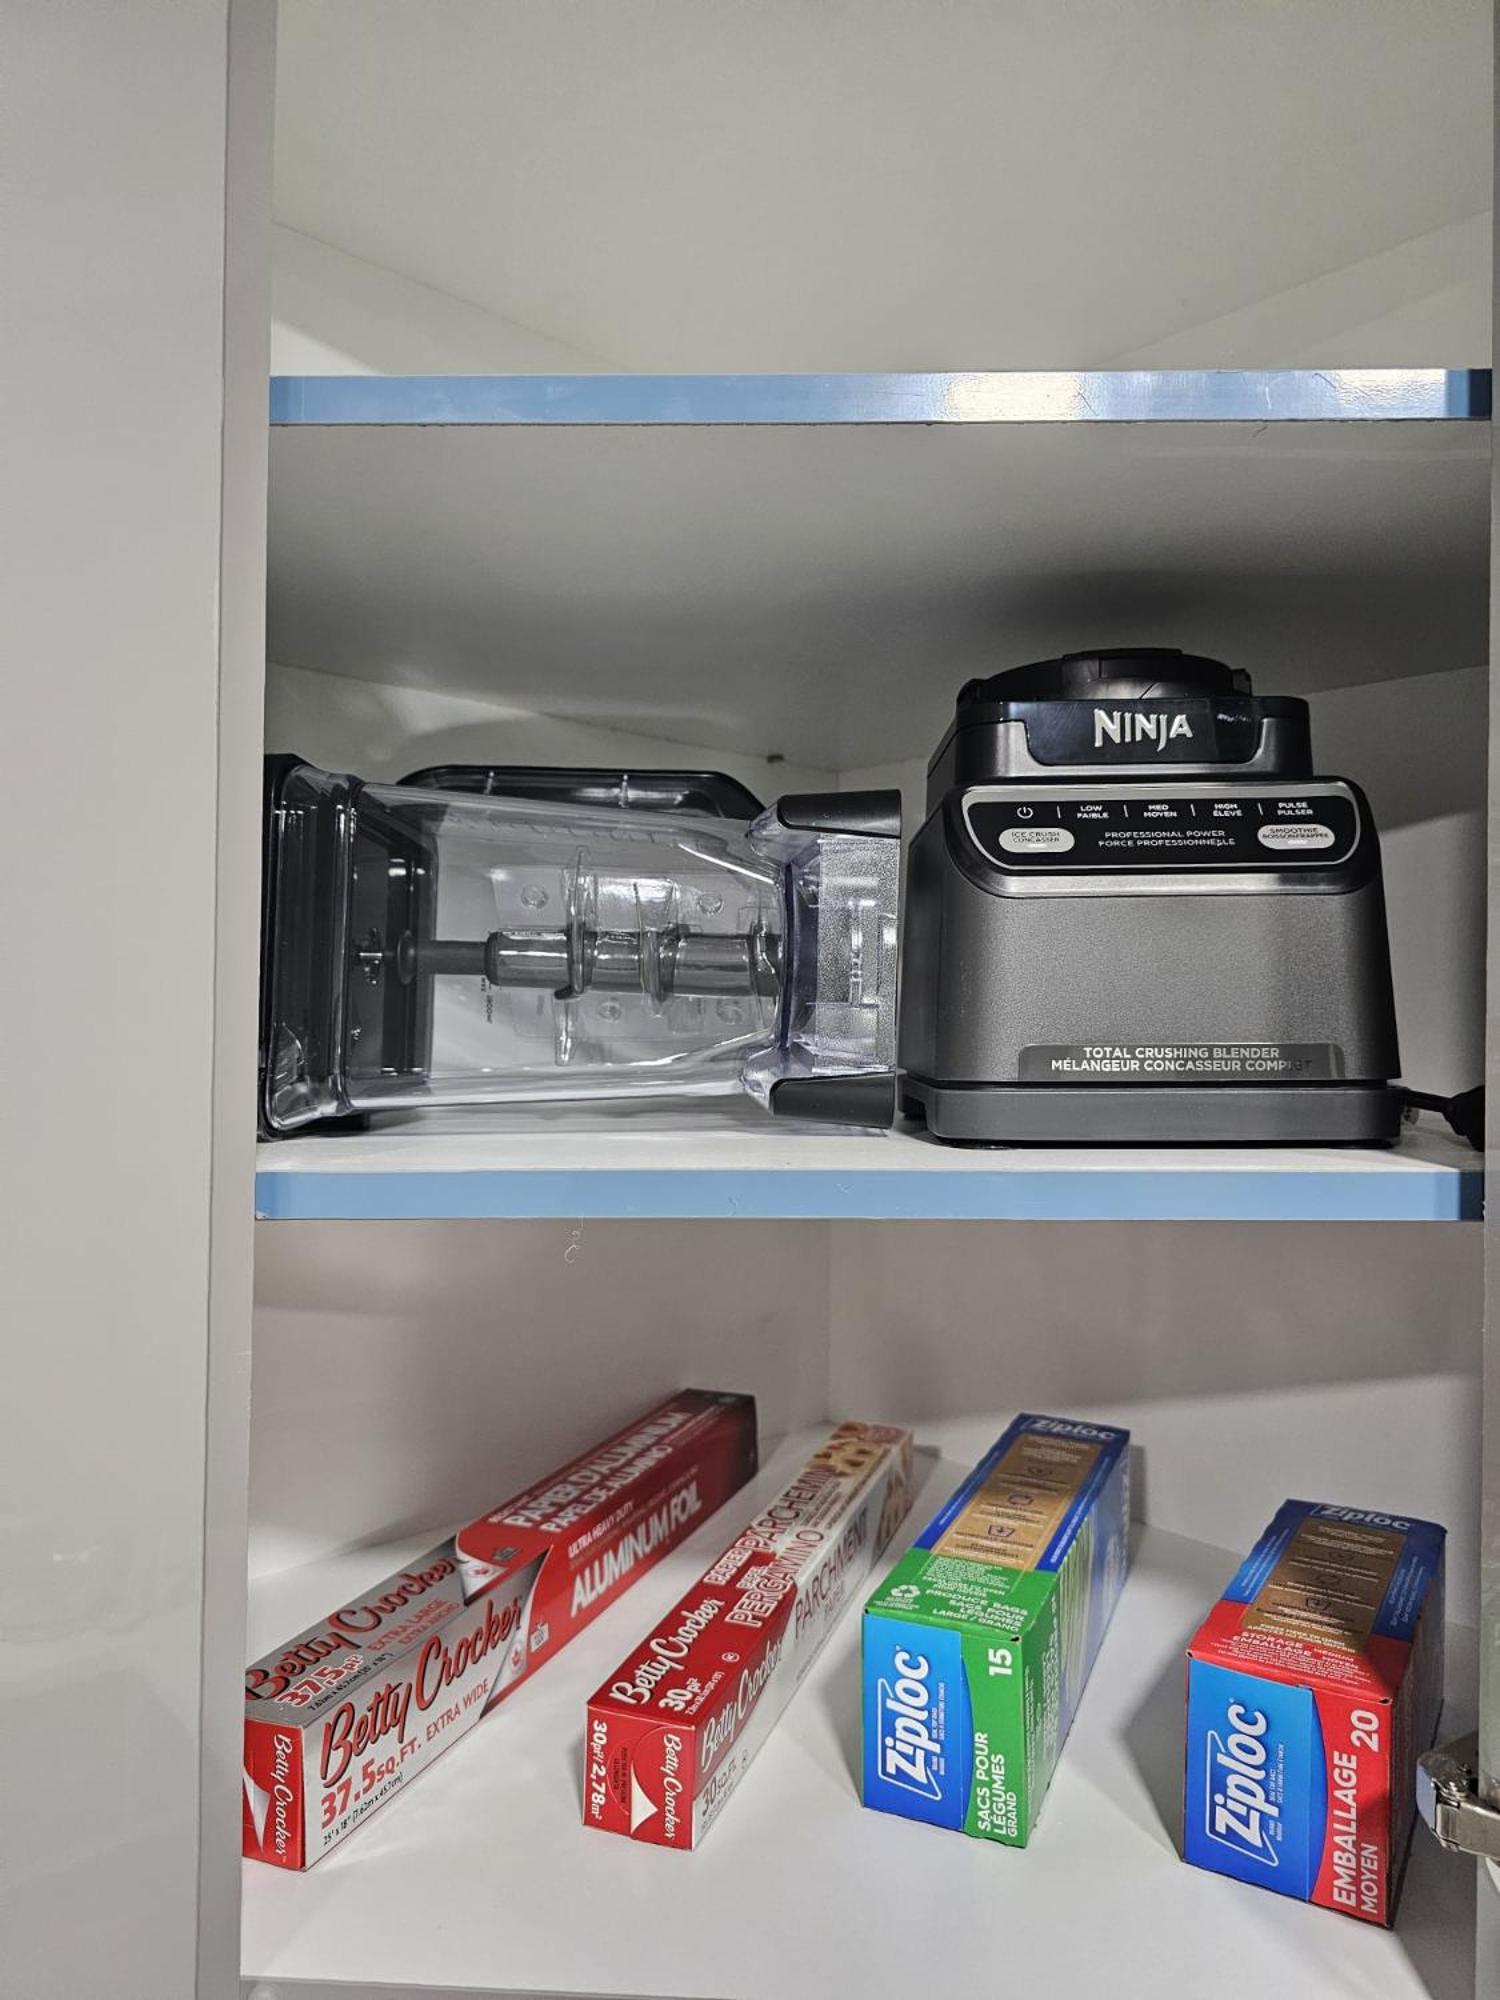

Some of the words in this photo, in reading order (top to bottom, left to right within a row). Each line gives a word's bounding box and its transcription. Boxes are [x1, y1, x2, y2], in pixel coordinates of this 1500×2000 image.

[1094, 708, 1193, 752] NINJA
[1051, 1057, 1140, 1072] MÉLANGEUR
[1143, 1060, 1240, 1072] CONCASSEUR
[1083, 1047, 1131, 1058] TOTAL
[1135, 1047, 1209, 1058] CRUSHING
[1213, 1047, 1280, 1058] BLENDER
[1031, 1418, 1116, 1440] Ziploc
[503, 1483, 580, 1527] PAPIER
[539, 1503, 598, 1533] PAPEL
[703, 1535, 753, 1586] PAPIER
[737, 1464, 837, 1552] PARCHEMIN
[1321, 1505, 1411, 1530] Ziploc
[568, 1531, 592, 1558] ULTRA
[570, 1508, 669, 1618] ALUMINUM
[670, 1481, 702, 1531] FOIL
[724, 1529, 824, 1628] PERGAMINO
[795, 1506, 868, 1640] PARCHMENT
[925, 1589, 988, 1605] PRODUCE
[993, 1602, 1028, 1616] BAGS
[932, 1608, 969, 1622] LARGE
[978, 1616, 1019, 1632] GRAND
[245, 1631, 362, 1700] Betty
[327, 1556, 462, 1632] Crocker
[609, 1655, 685, 1705] Betty
[649, 1598, 725, 1658] Crocker
[1232, 1636, 1312, 1657] EMBALLAGE
[1241, 1631, 1304, 1649] STORAGE
[988, 1648, 1013, 1676] 15
[320, 1682, 413, 1788] Betty
[415, 1597, 522, 1711] Crocker
[427, 1703, 461, 1741] EXTRA
[462, 1678, 489, 1709] WIDE
[701, 1701, 738, 1773] Betty
[885, 1650, 941, 1784] Ziploc
[1350, 1709, 1380, 1753] 20
[271, 1734, 292, 1782] Betty
[660, 1733, 682, 1776] Betty
[974, 1732, 989, 1781] POUR
[1214, 1703, 1279, 1848] Ziploc
[663, 1777, 683, 1839] Crocker
[977, 1787, 992, 1831] SACS
[990, 1754, 1006, 1835] LÉGUMES
[1004, 1791, 1017, 1837] GRAND
[274, 1785, 294, 1855] Crocker
[1333, 1750, 1357, 1907] EMBALLAGE
[1361, 1843, 1379, 1914] MOYEN
